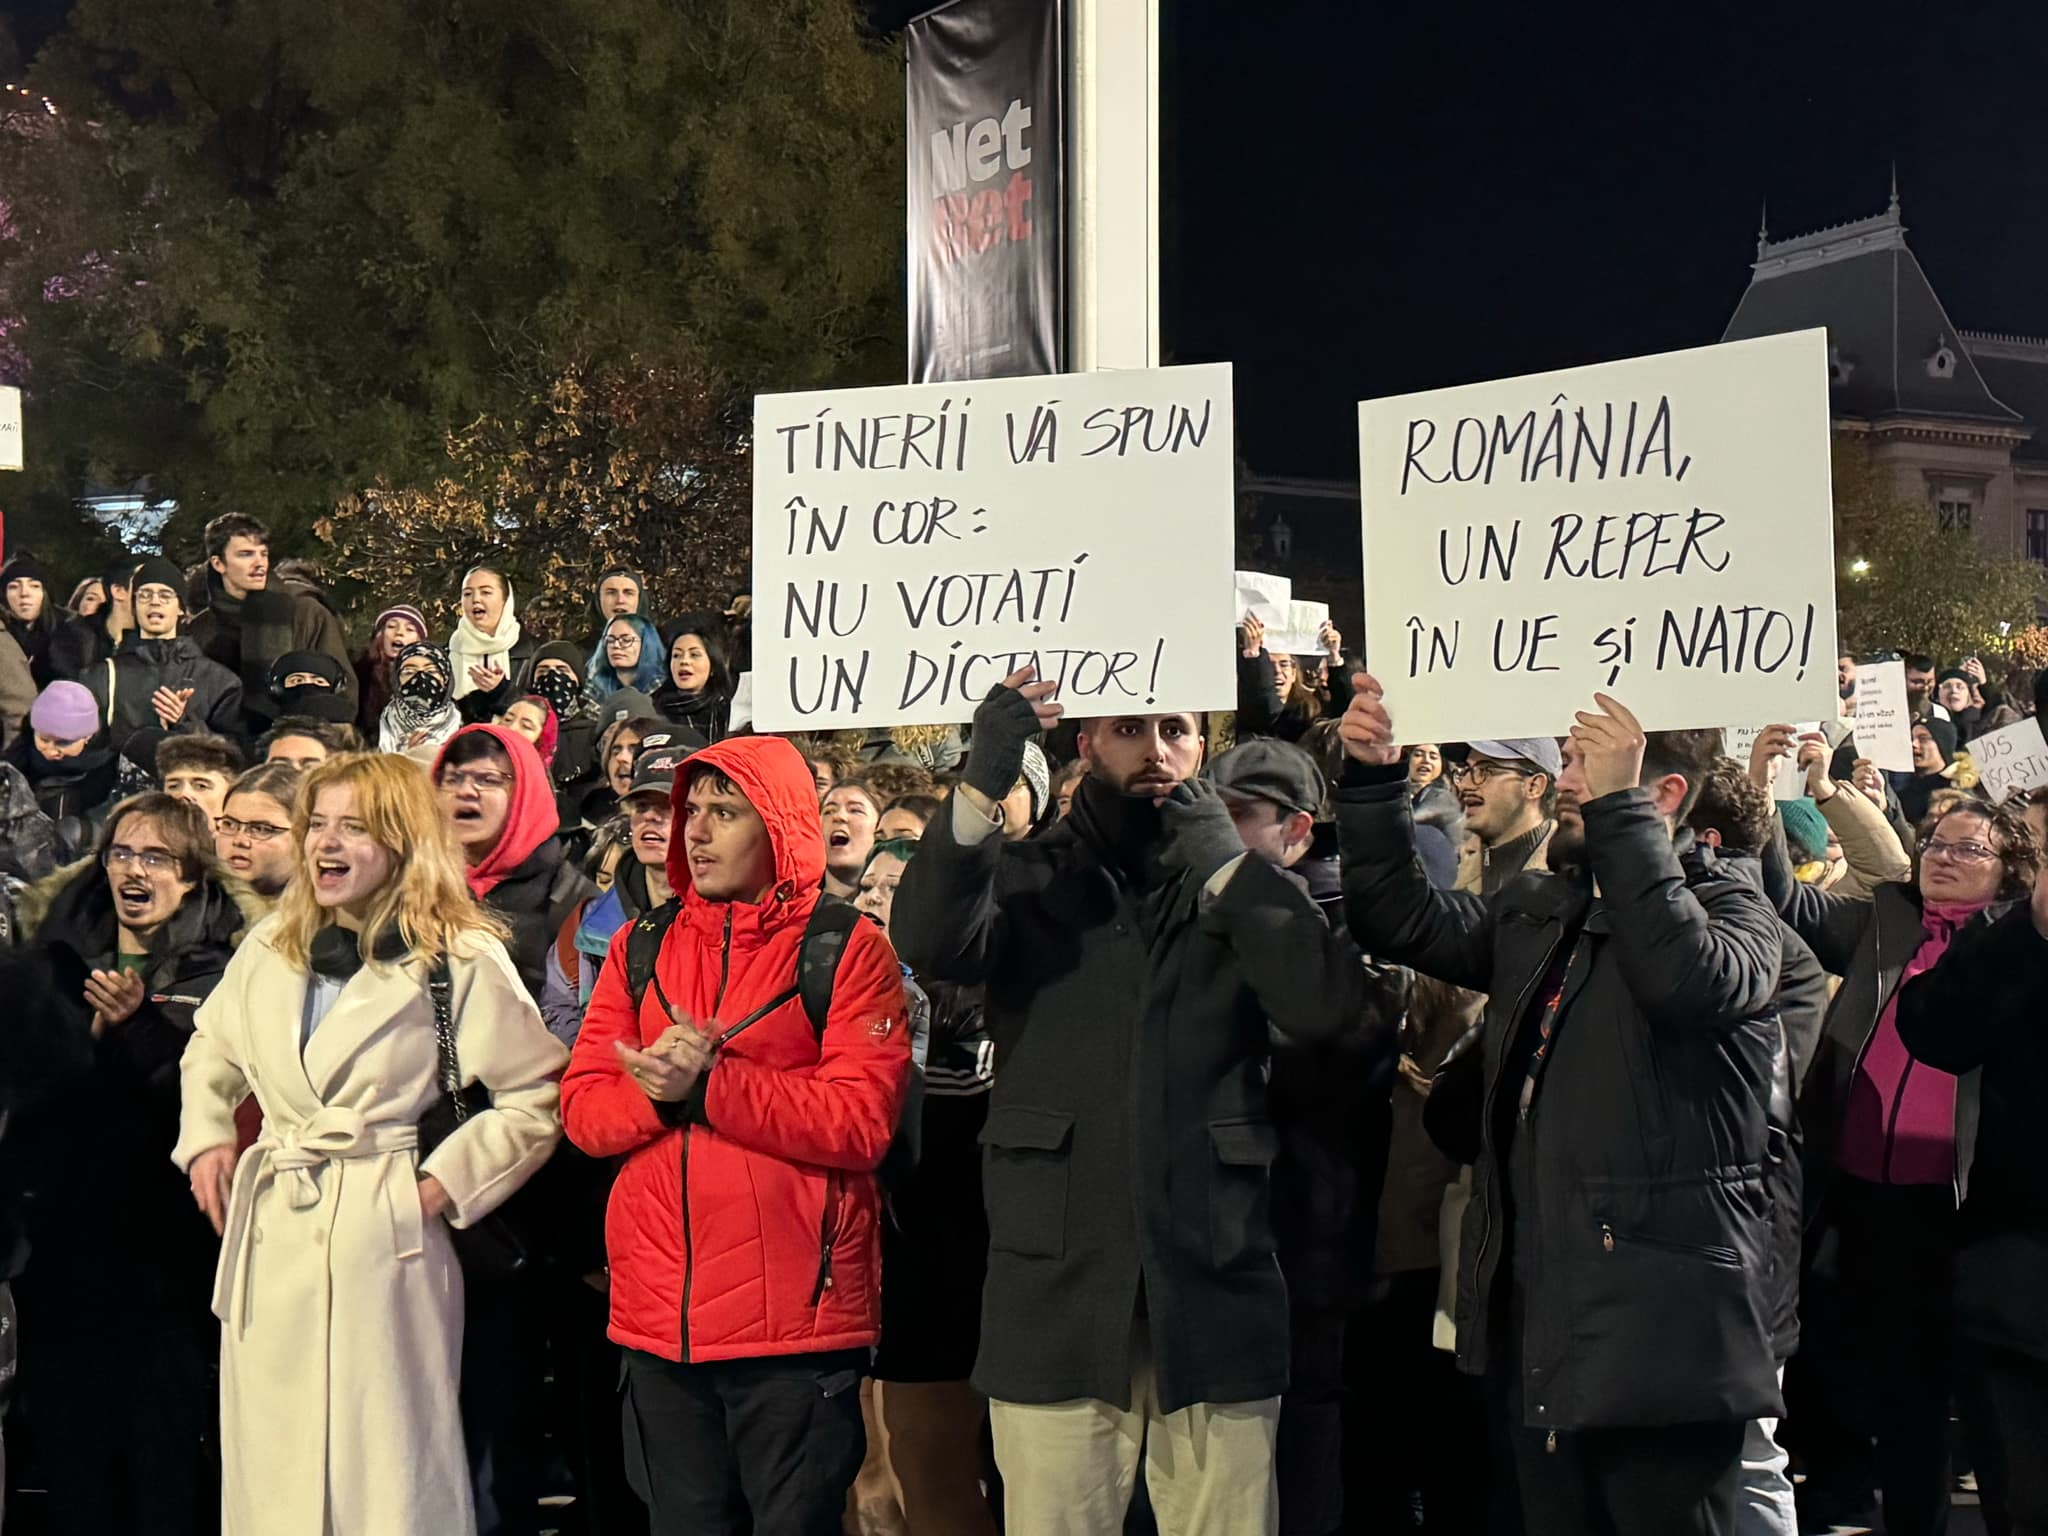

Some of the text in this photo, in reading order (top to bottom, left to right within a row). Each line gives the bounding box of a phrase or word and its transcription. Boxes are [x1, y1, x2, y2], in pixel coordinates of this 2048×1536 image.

[931, 99, 1032, 198] Net
[1081, 400, 1211, 457] SPUN
[1401, 393, 1692, 495] ROMÂNIA,
[784, 497, 987, 555] ÎN COR:
[1440, 508, 1730, 586] UN REPER
[784, 580, 868, 639] NU
[1406, 616, 1460, 678] ÎN
[1493, 615, 1561, 672] UE
[1656, 604, 1814, 682] NATO!
[789, 651, 870, 715] UN
[1979, 735, 2013, 763] JOS
